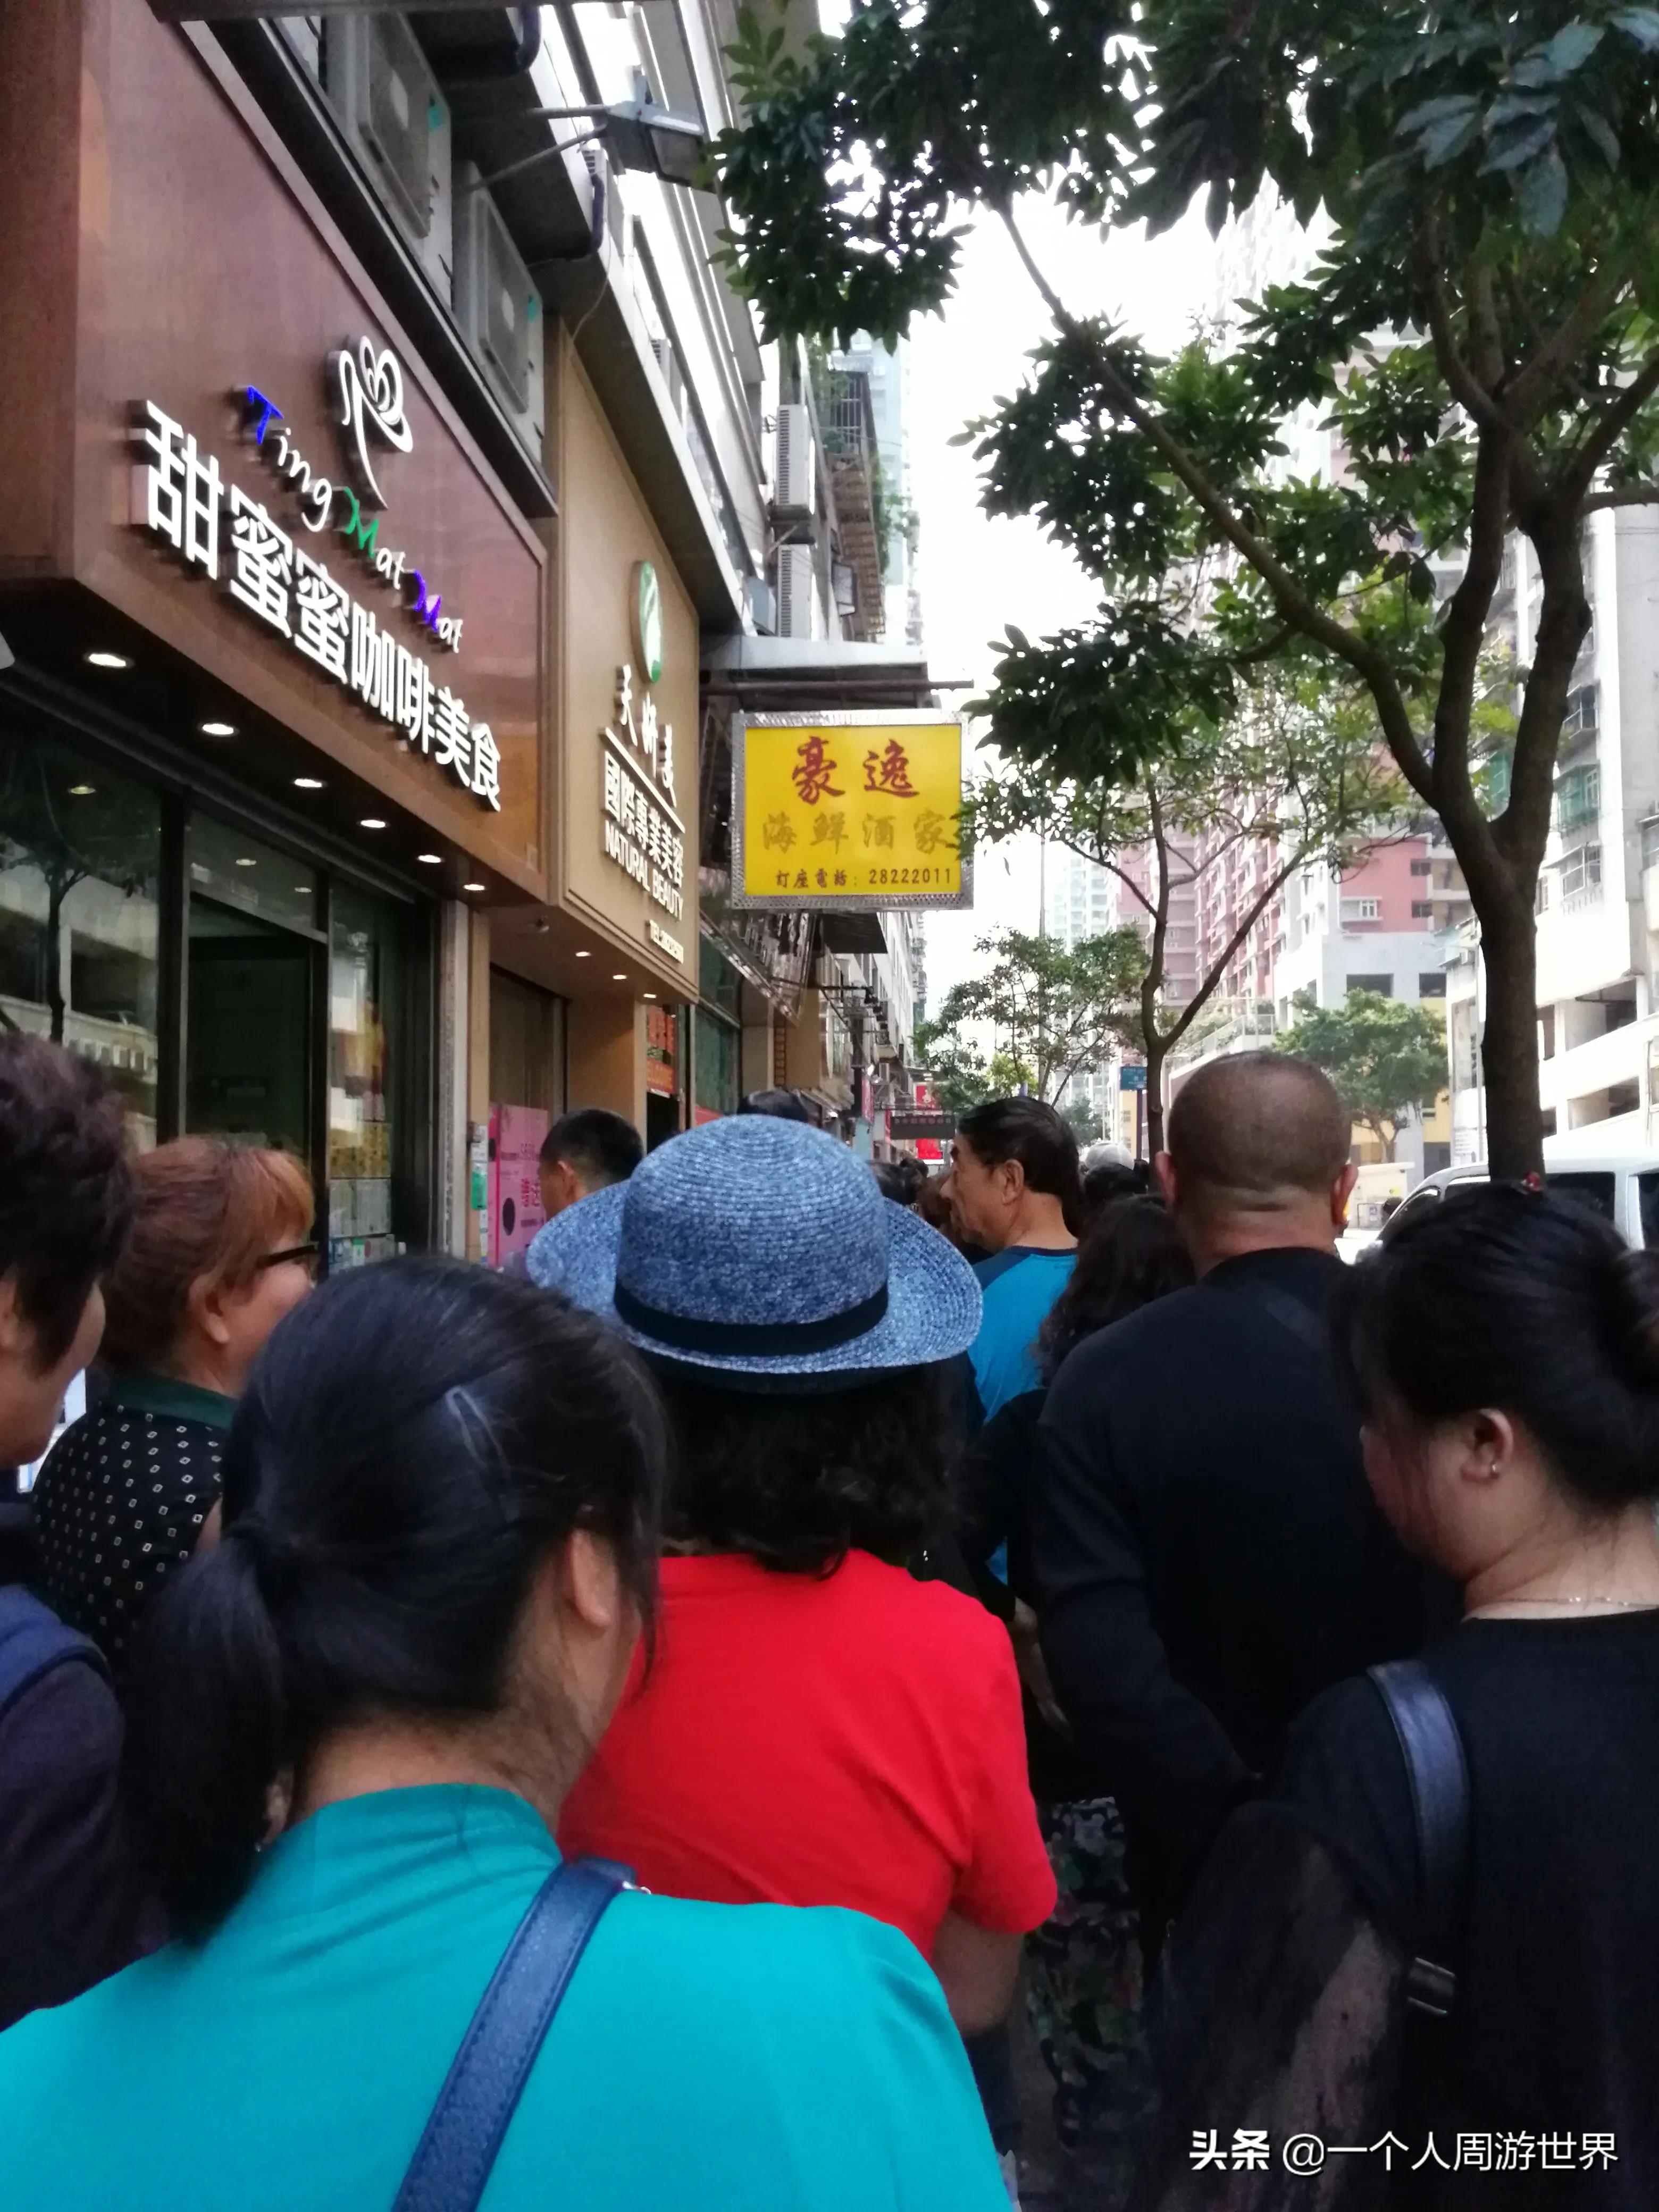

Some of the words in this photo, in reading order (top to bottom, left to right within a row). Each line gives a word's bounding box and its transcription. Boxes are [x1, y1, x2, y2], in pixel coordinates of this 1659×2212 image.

[247, 385, 332, 532] Ting
[344, 486, 406, 589] Mat
[414, 569, 463, 653] Mat
[145, 399, 501, 812] 甜蜜蜜咖啡美食
[792, 735, 920, 805] 豪逸
[605, 819, 650, 892] NATURAL
[652, 868, 684, 921] BEAUTY
[763, 808, 948, 854] 海鮮酒家
[869, 868, 951, 885] 28222011
